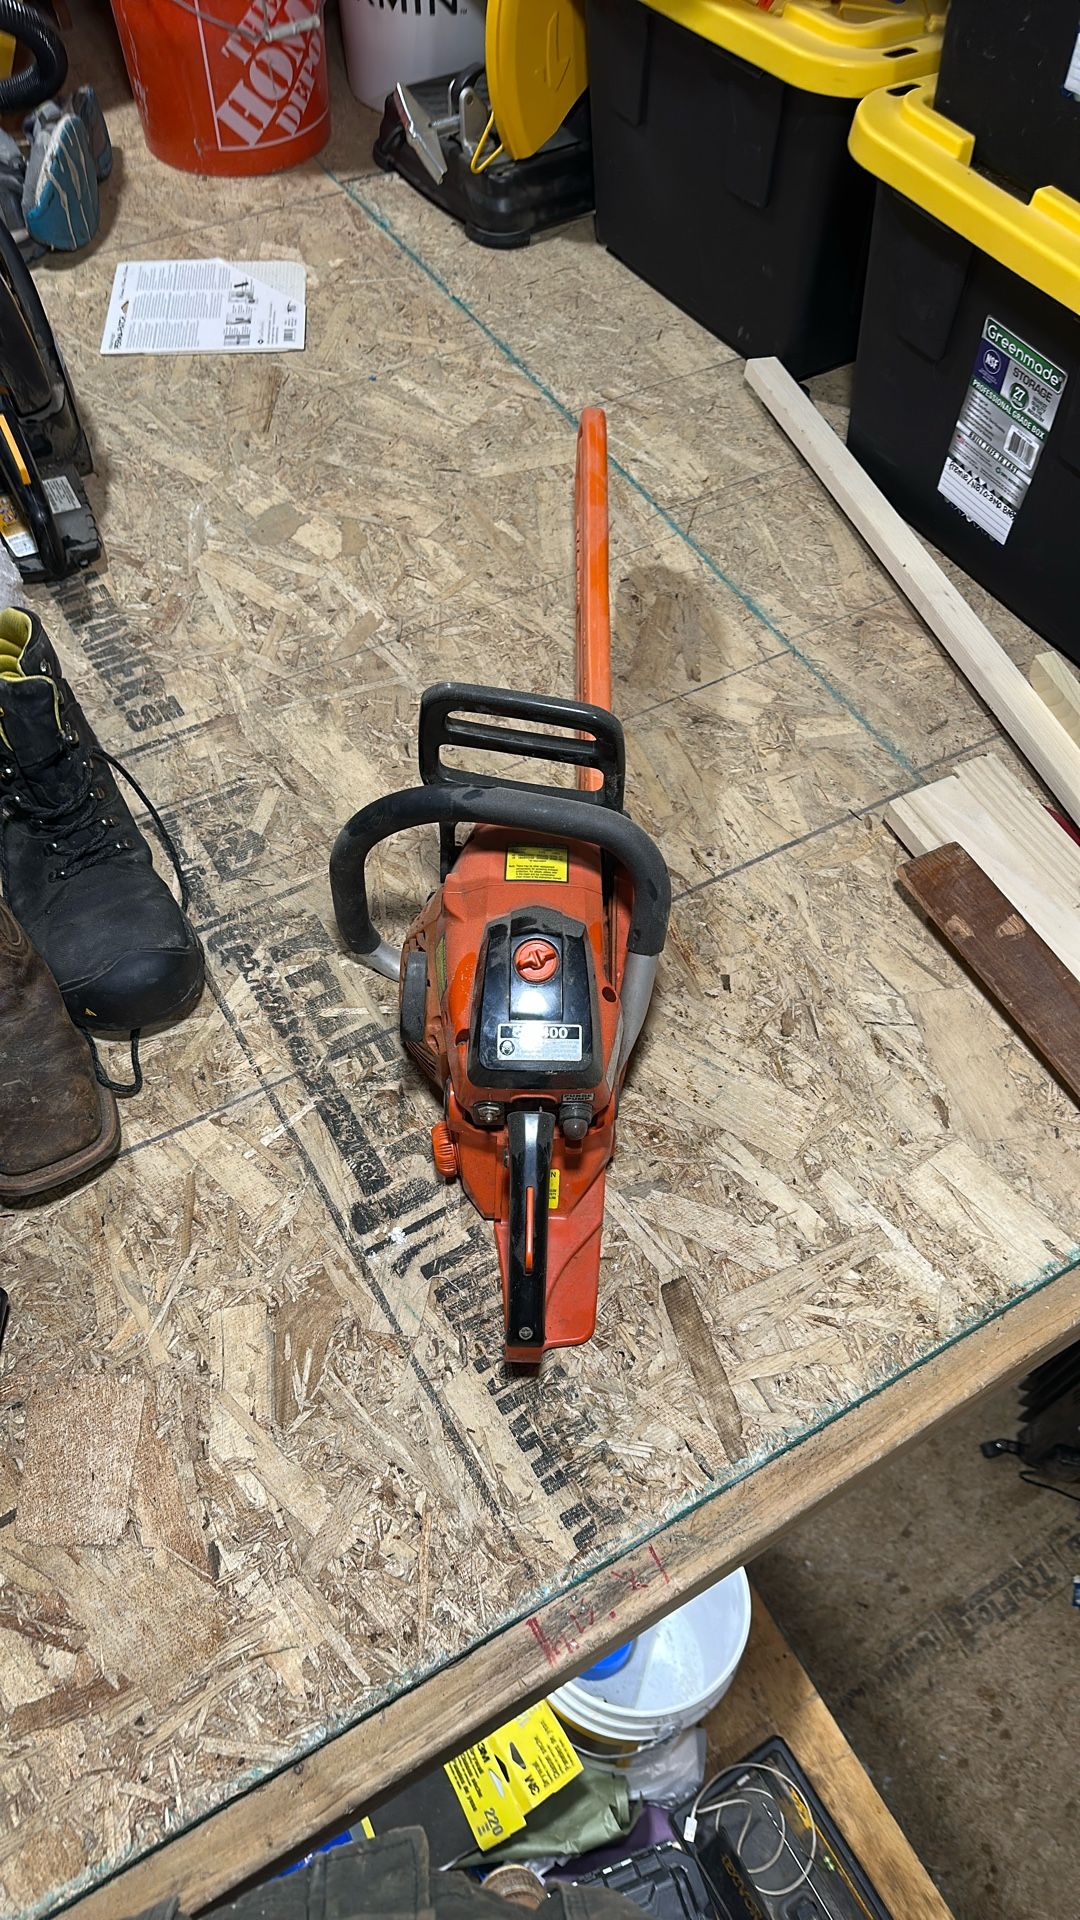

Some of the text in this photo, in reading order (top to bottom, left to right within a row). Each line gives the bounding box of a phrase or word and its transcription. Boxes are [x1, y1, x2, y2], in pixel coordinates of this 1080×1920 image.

[367, 0, 458, 16] MIN
[221, 0, 282, 65] THE
[217, 0, 318, 147] HOM
[276, 28, 320, 136] DEPO
[985, 354, 999, 369] NSF
[987, 324, 1060, 386] Greenmade
[1012, 367, 1053, 403] STORAGE
[1013, 386, 1026, 401] 27
[972, 379, 1012, 415] PROFESSIONAL
[1011, 410, 1033, 430] GRADE
[1030, 424, 1046, 440] BOX
[476, 1742, 491, 1764] 3M
[523, 1773, 541, 1797] 3M
[483, 1807, 504, 1836] 220
